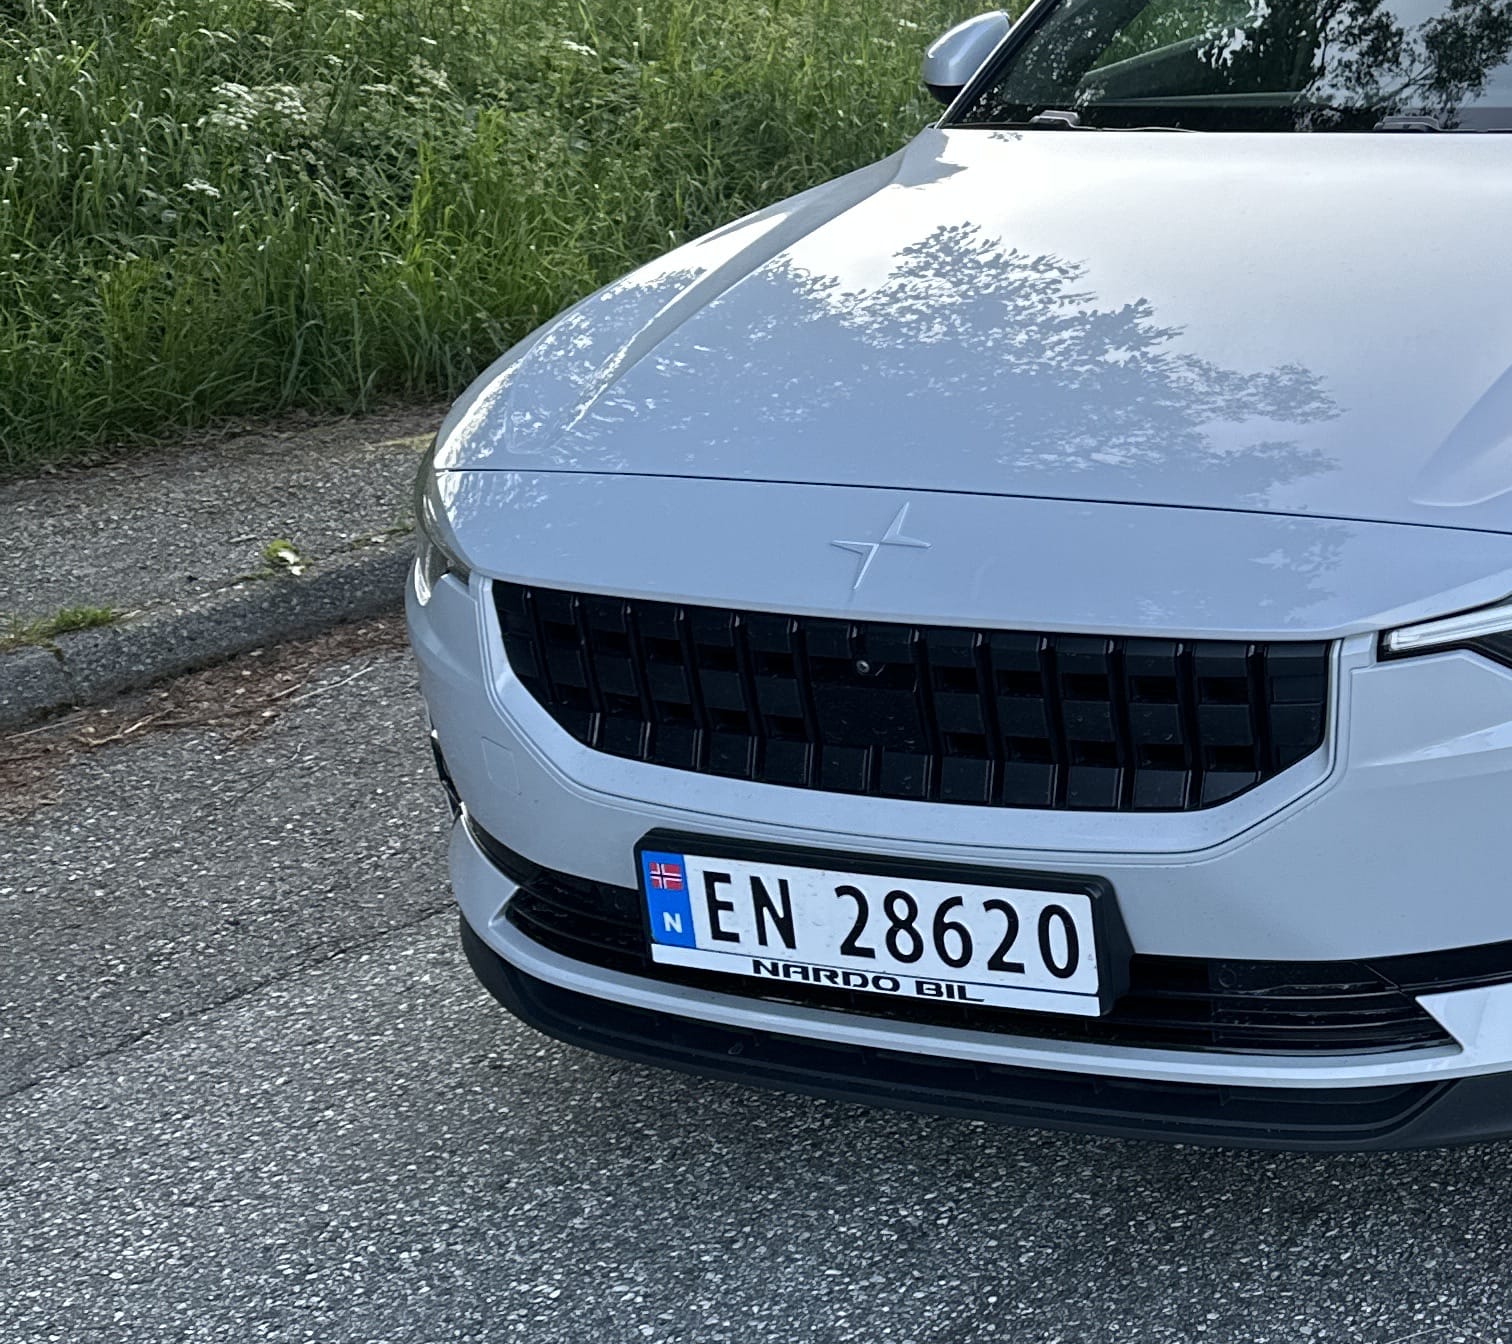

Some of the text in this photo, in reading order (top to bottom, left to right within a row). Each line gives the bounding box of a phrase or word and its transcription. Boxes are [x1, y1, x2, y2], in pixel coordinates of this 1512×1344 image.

[664, 912, 682, 933] N
[703, 870, 1079, 979] EN 28620
[753, 960, 984, 1003] NARDO BIL
